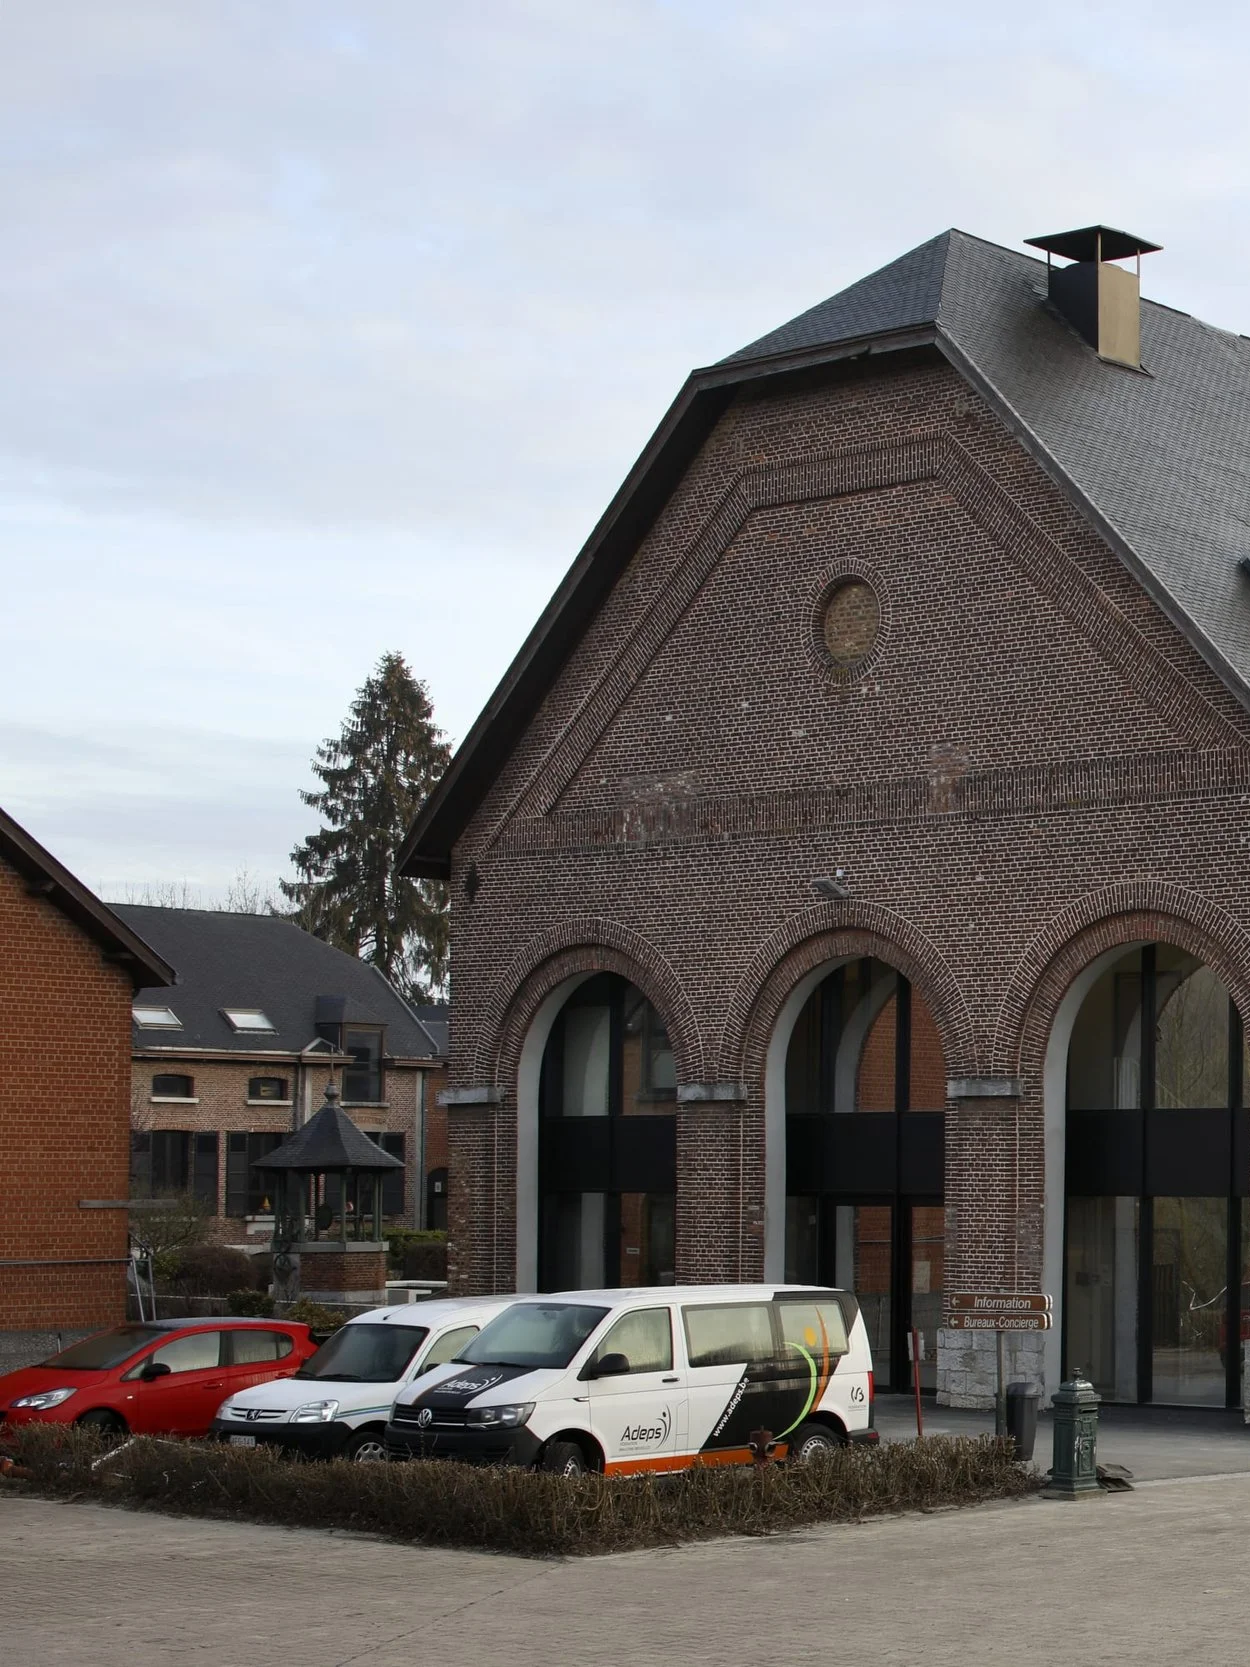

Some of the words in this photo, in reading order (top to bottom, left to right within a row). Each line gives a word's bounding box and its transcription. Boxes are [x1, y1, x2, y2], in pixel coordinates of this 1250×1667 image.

[974, 1296, 1031, 1309] Information
[963, 1316, 1039, 1329] Bureaux-Concierge
[713, 1377, 750, 1437] www.adeps.be
[620, 1425, 662, 1442] Adeps
